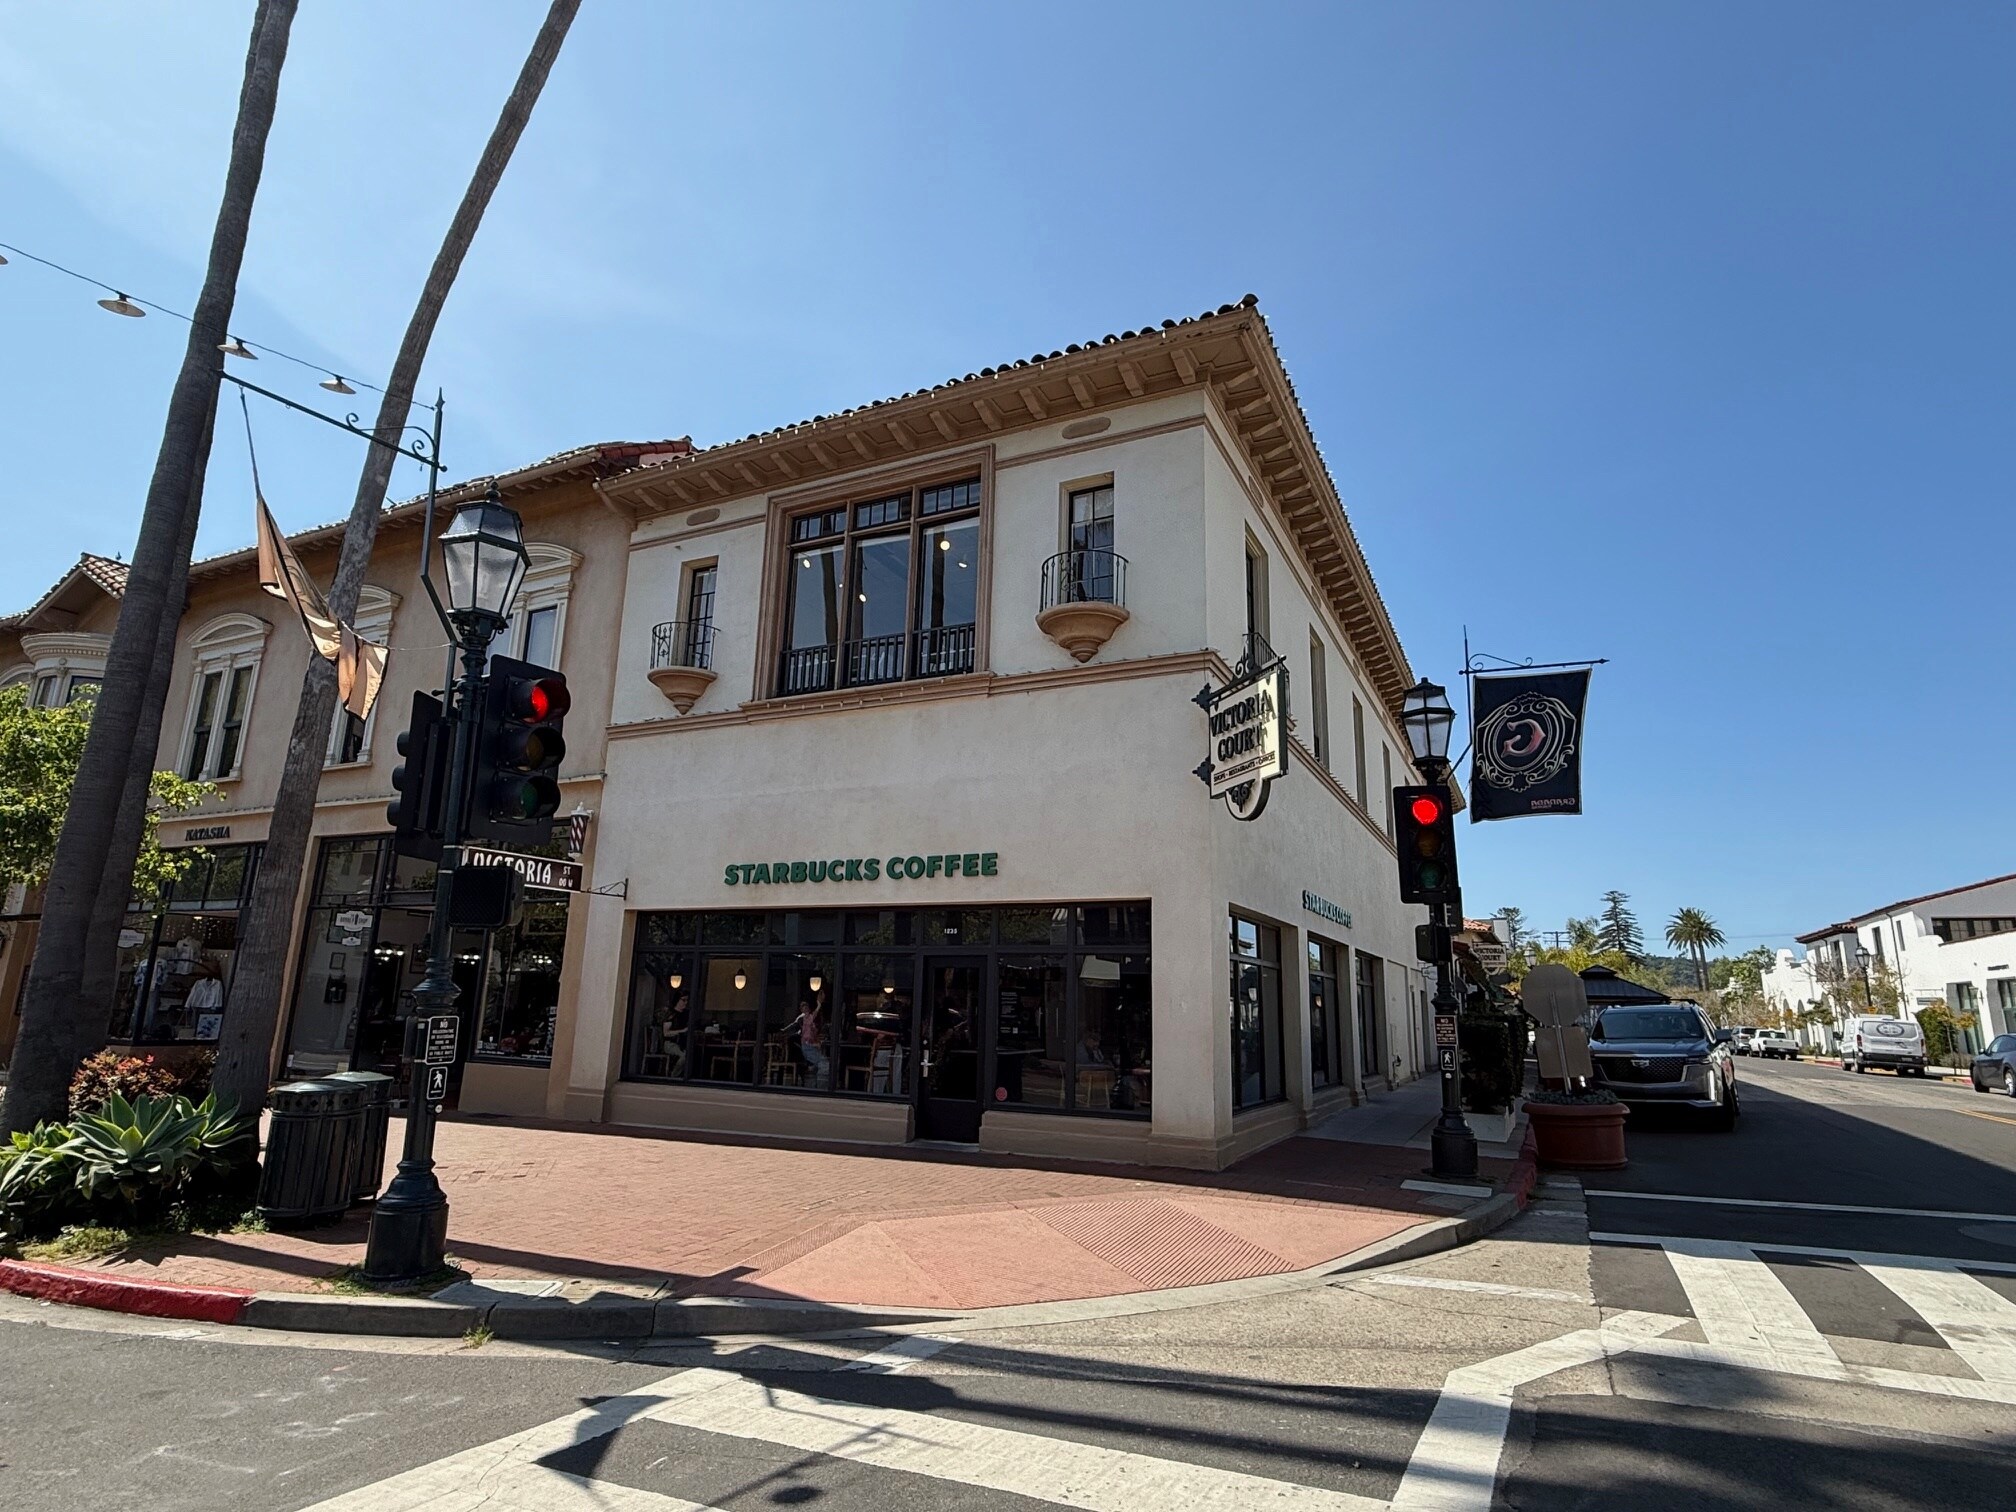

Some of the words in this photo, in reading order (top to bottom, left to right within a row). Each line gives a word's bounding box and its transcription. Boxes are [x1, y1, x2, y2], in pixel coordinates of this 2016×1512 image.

[1210, 689, 1272, 737] VICTORIA
[1217, 721, 1263, 762] COURT
[184, 826, 230, 841] NATASHA
[563, 866, 571, 875] ST
[724, 858, 880, 886] STARBUCKS
[886, 853, 998, 880] COFFEE
